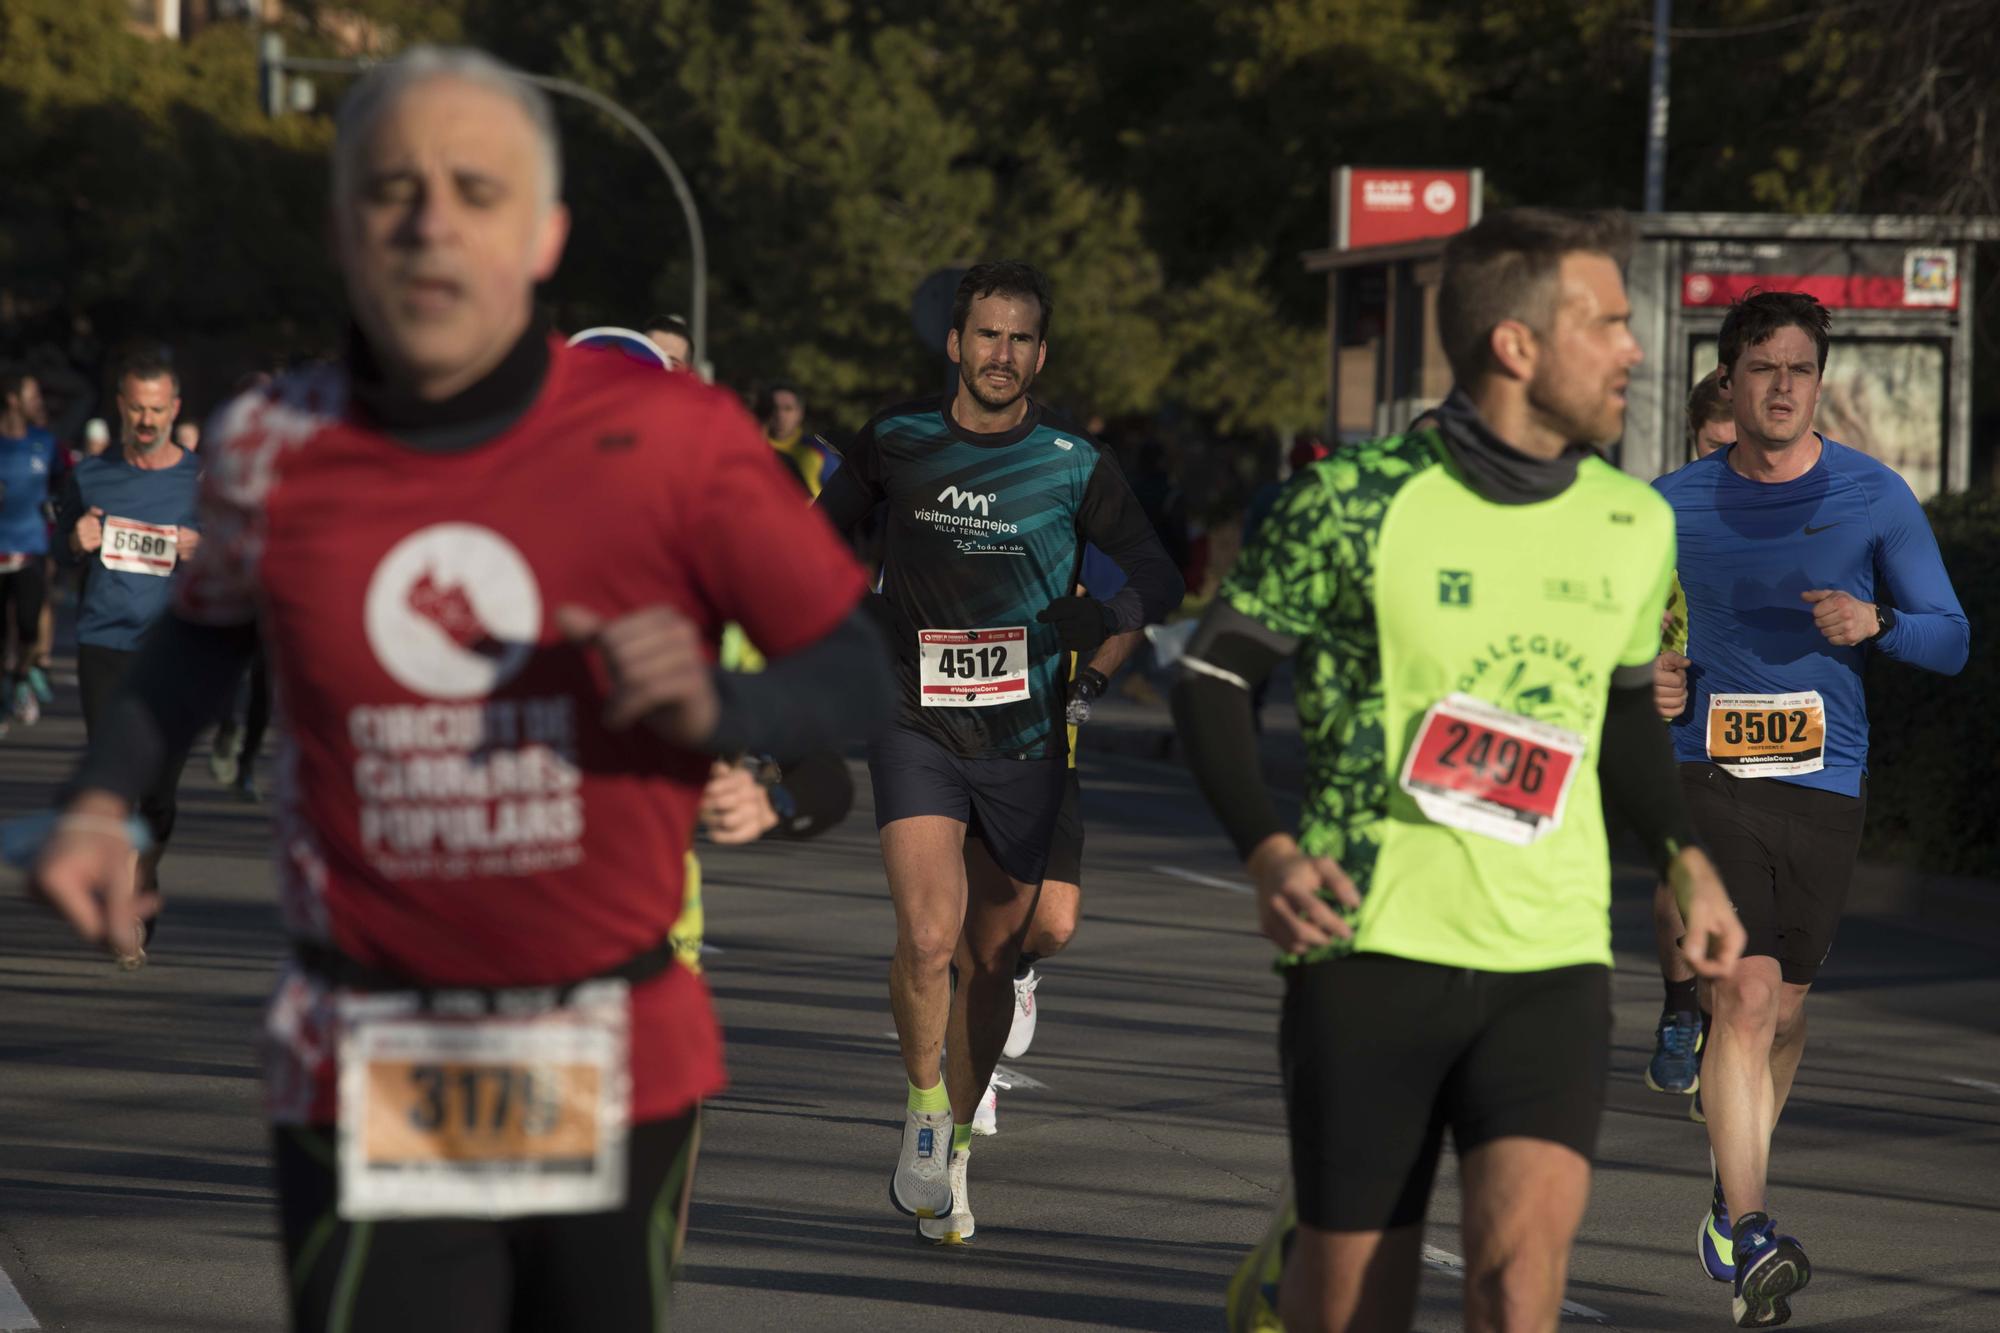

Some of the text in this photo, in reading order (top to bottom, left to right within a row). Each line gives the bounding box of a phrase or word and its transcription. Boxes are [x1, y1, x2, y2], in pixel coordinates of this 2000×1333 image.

[914, 508, 1018, 535] visitmontanejos
[934, 524, 990, 538] VILLA TERMAL
[977, 543, 997, 551] todo
[1000, 543, 1007, 551] el
[939, 645, 1008, 679] 4512
[1724, 710, 1808, 744] 3502
[1437, 722, 1551, 794] 2496
[1740, 755, 1793, 763] #ValènciaCorre
